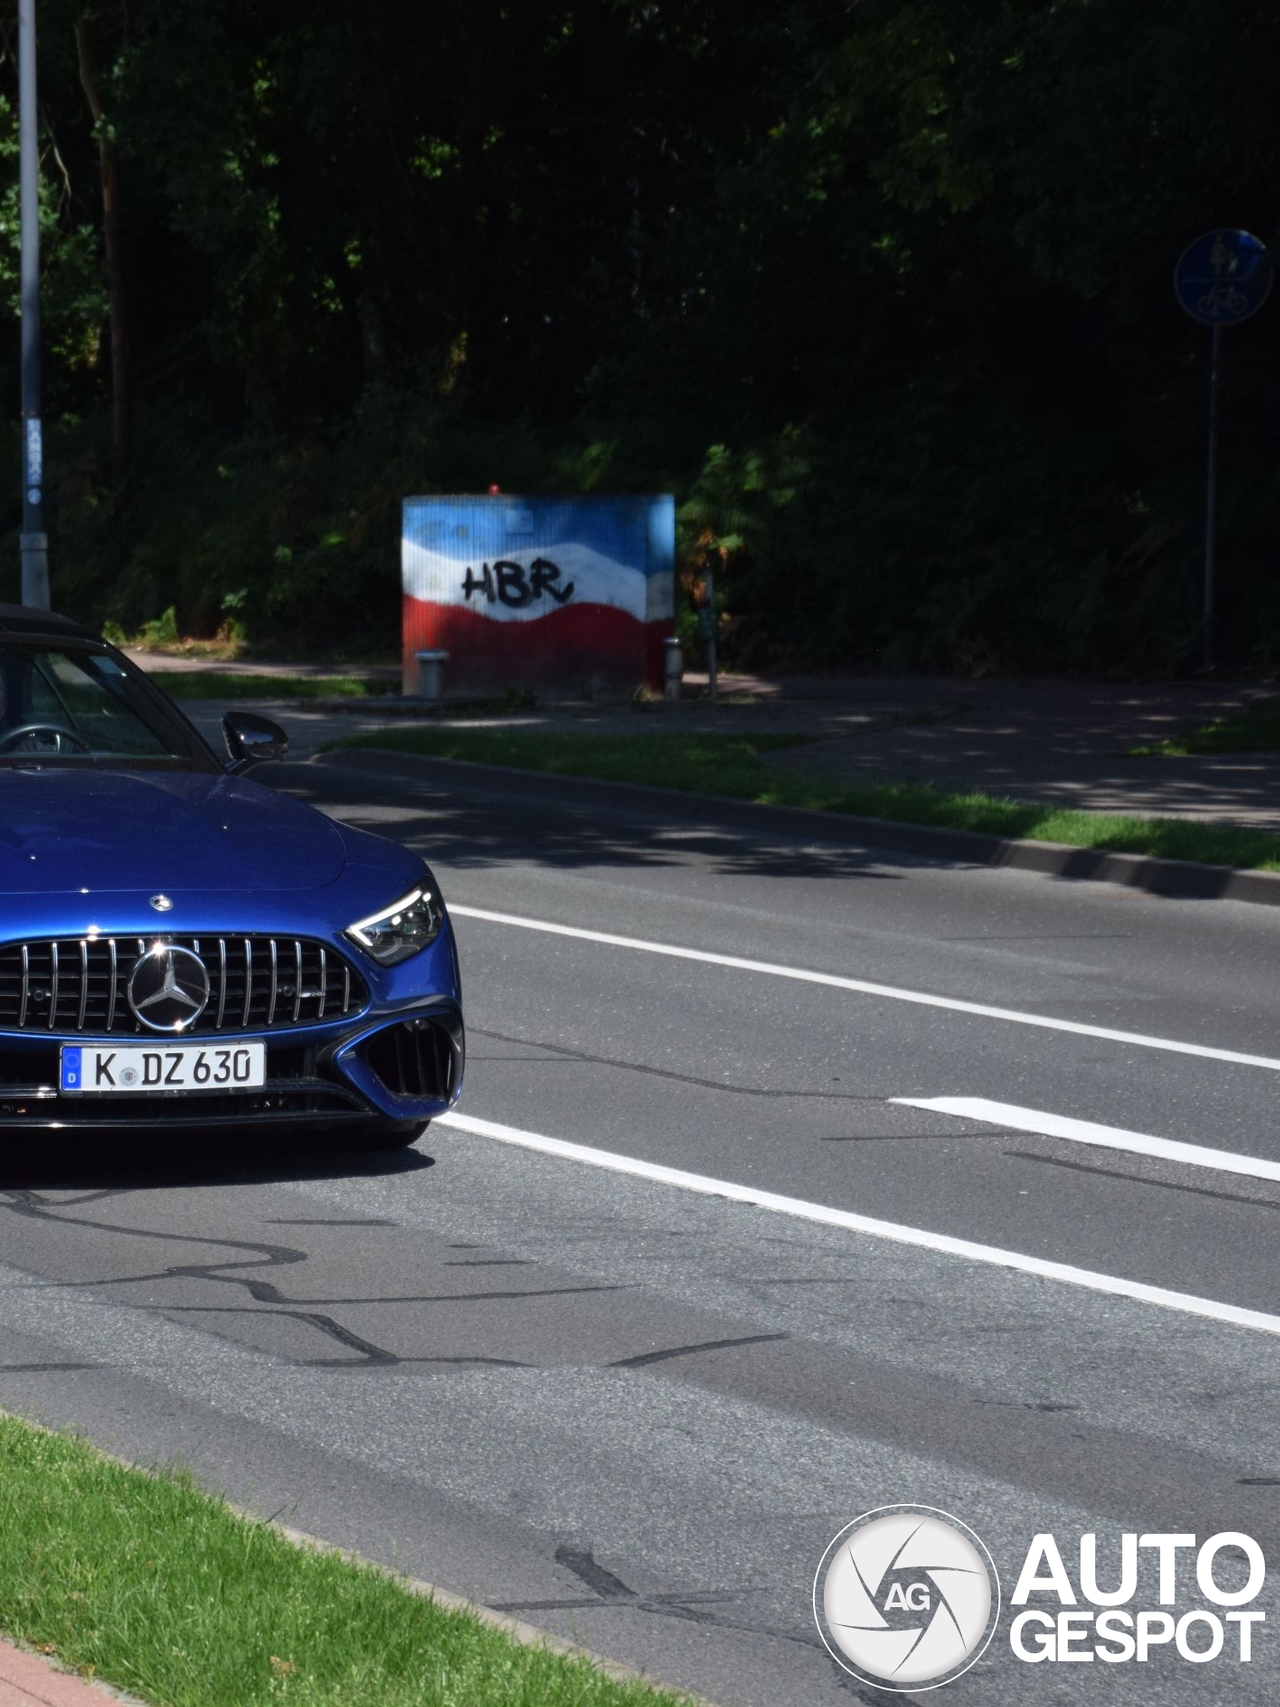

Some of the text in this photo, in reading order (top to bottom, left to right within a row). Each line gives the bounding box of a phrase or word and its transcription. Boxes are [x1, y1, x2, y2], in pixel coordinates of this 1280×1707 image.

[461, 556, 575, 608] HBR
[68, 1073, 77, 1084] D
[95, 1049, 251, 1086] K DZ 630
